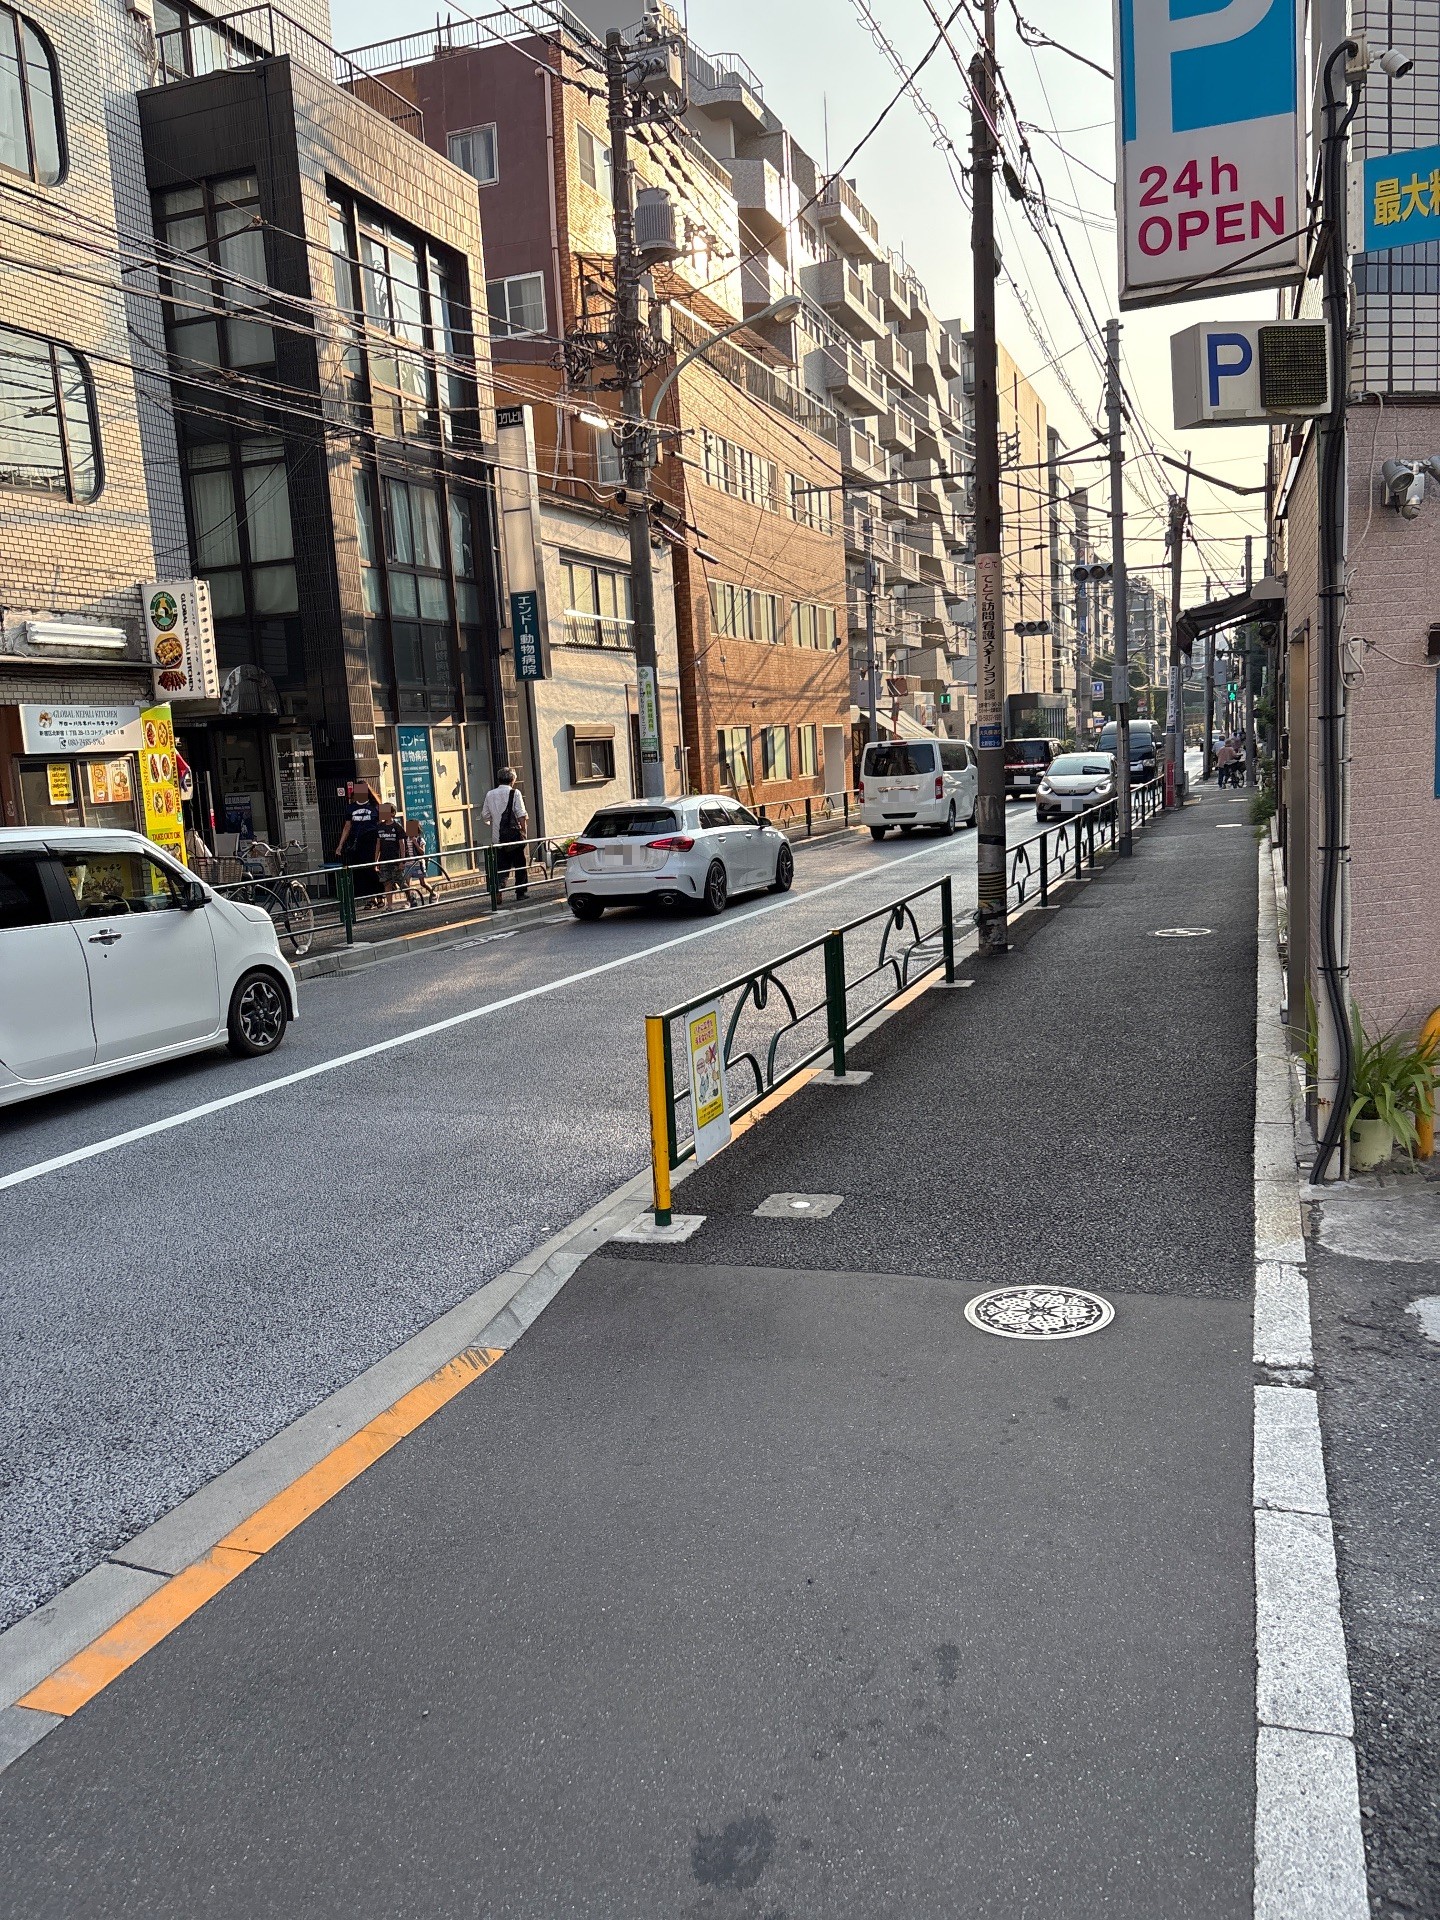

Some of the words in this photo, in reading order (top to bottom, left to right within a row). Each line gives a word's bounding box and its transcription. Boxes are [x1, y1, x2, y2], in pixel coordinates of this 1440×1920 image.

[1138, 155, 1239, 208] 24h
[1138, 195, 1286, 257] OPEN
[1206, 332, 1253, 407] P
[977, 561, 998, 570] てとて
[180, 593, 188, 626] GLOBAL
[183, 627, 191, 656] NEPALI
[517, 595, 538, 676] エンドー動物病院
[981, 574, 996, 686] てとて訪問看護ステーション
[186, 655, 194, 692] KITCHEN
[52, 710, 75, 718] GLOBAL
[75, 710, 94, 718] NEPALI
[94, 710, 118, 718] KITCHEN
[167, 720, 175, 751] GLOBAL
[400, 733, 425, 747] エンドー
[170, 751, 178, 777] NEPALI
[401, 749, 429, 763] 動物病院
[173, 777, 181, 814] KITCHEN
[152, 833, 164, 842] TAKE
[164, 832, 174, 841] OUT
[174, 831, 181, 839] OK
